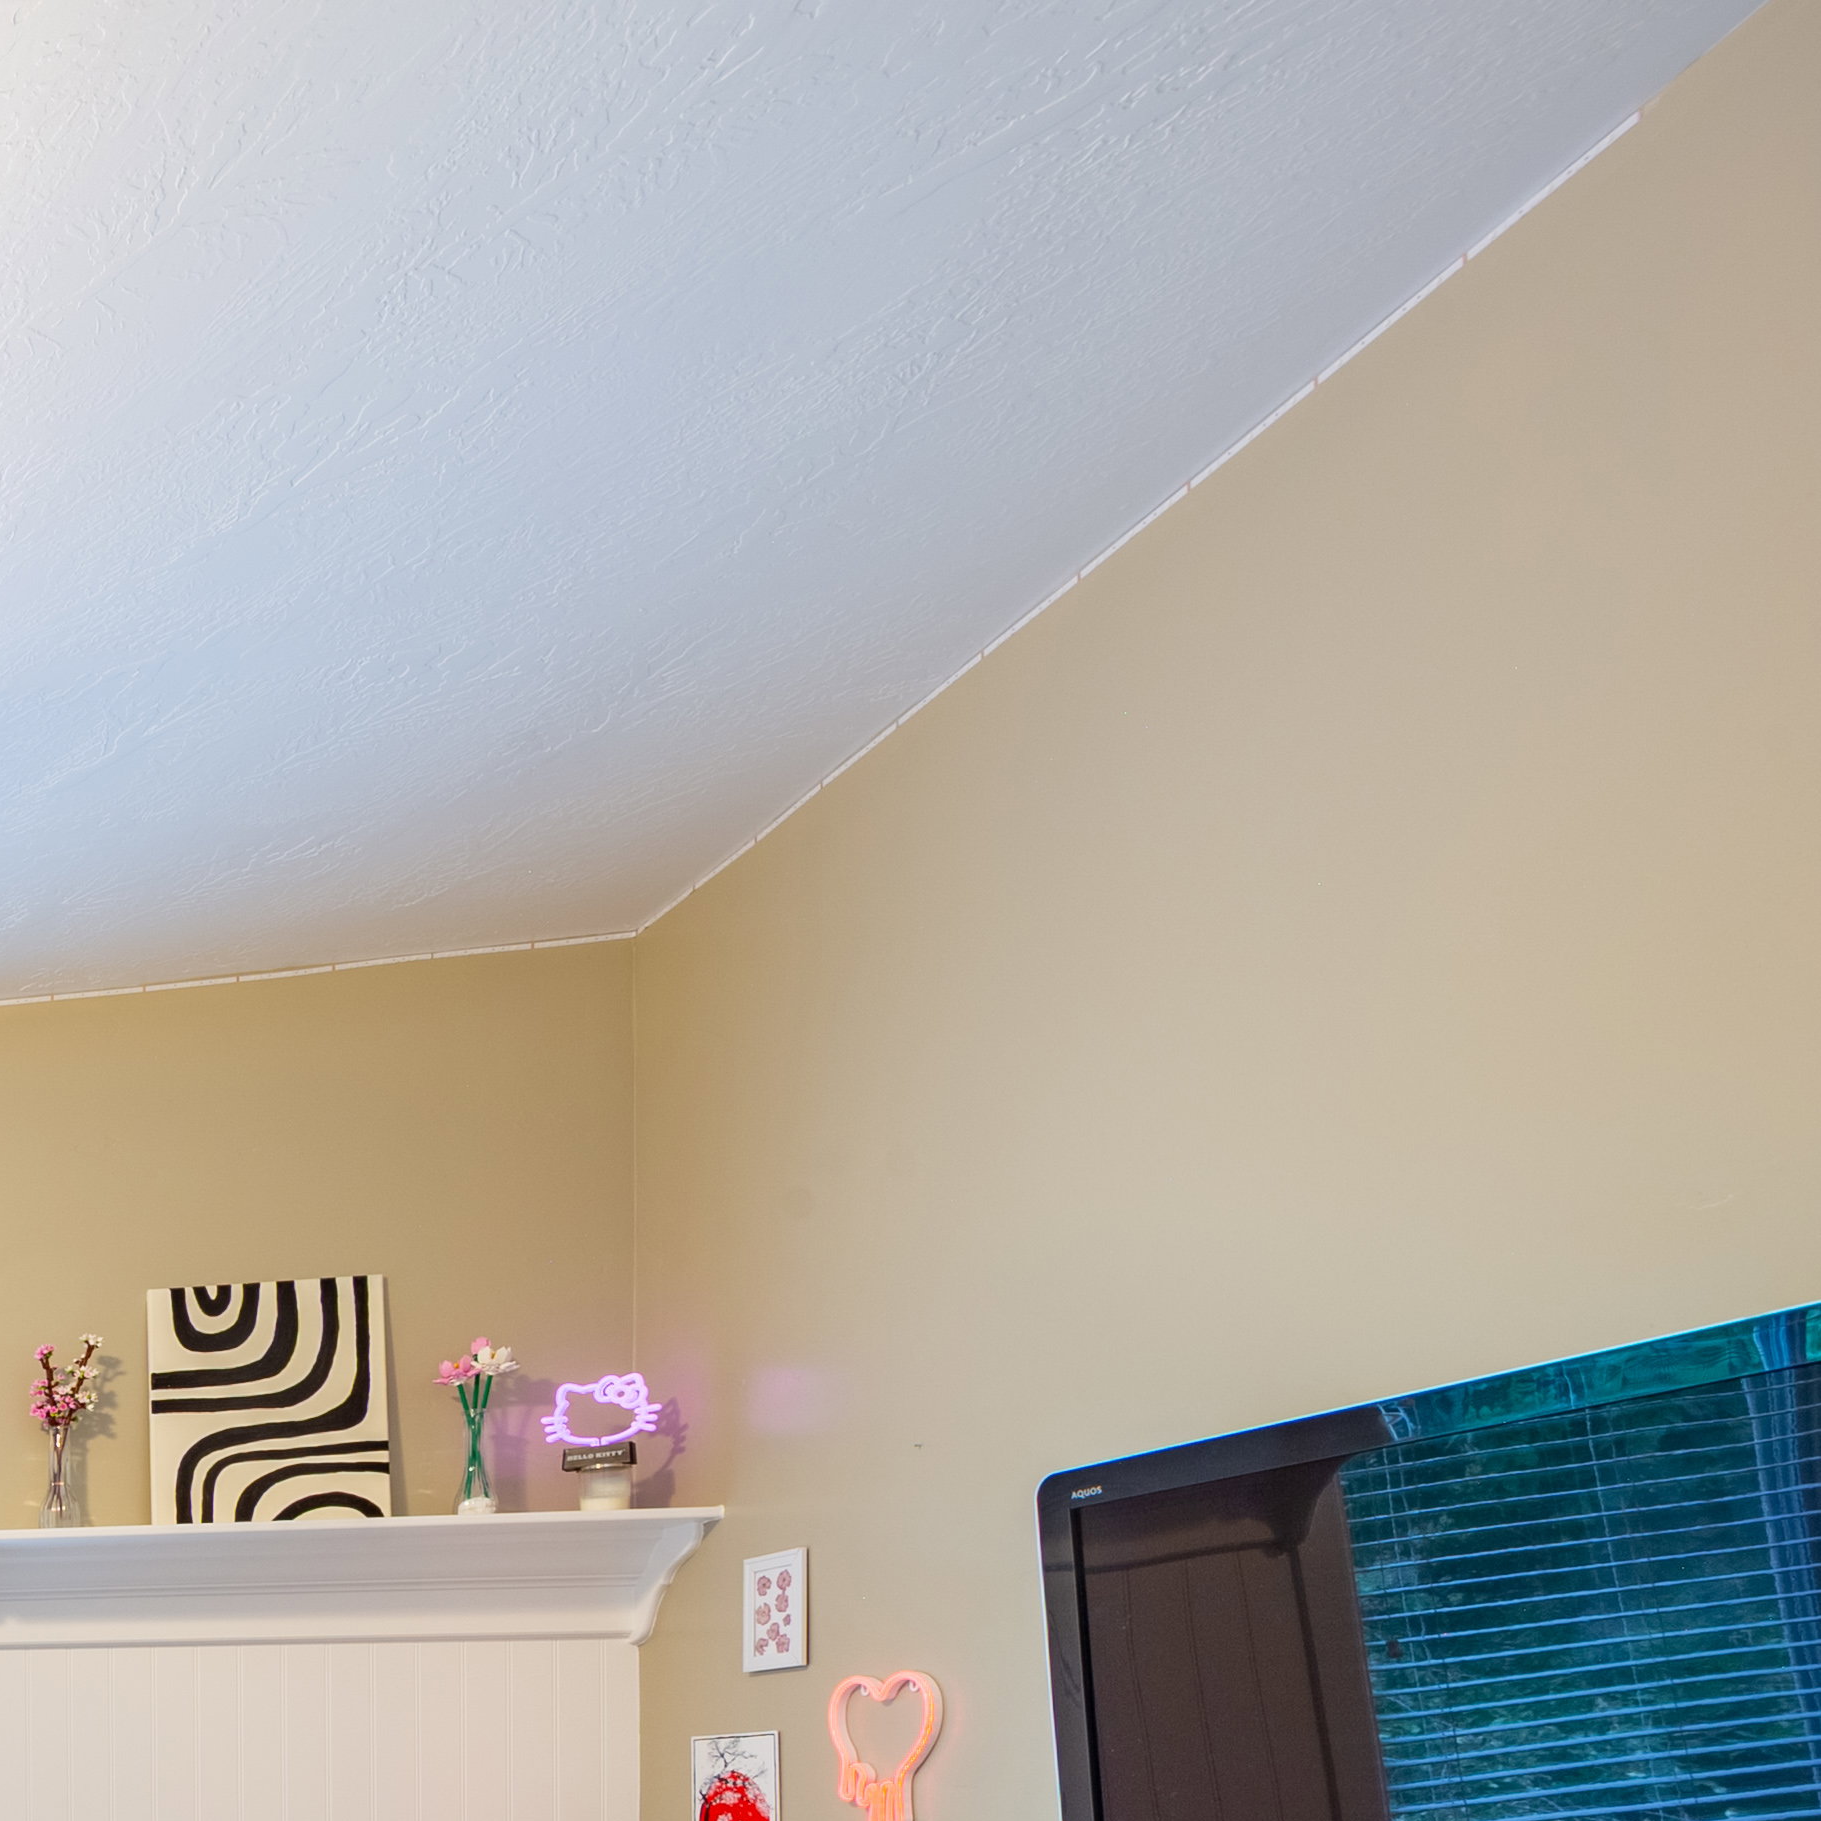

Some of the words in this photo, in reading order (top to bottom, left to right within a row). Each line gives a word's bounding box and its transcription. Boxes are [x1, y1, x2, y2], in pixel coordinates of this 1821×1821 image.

[566, 1452, 595, 1462] HELLO
[596, 1449, 624, 1459] KITTY
[1071, 1485, 1102, 1499] AQUOS
